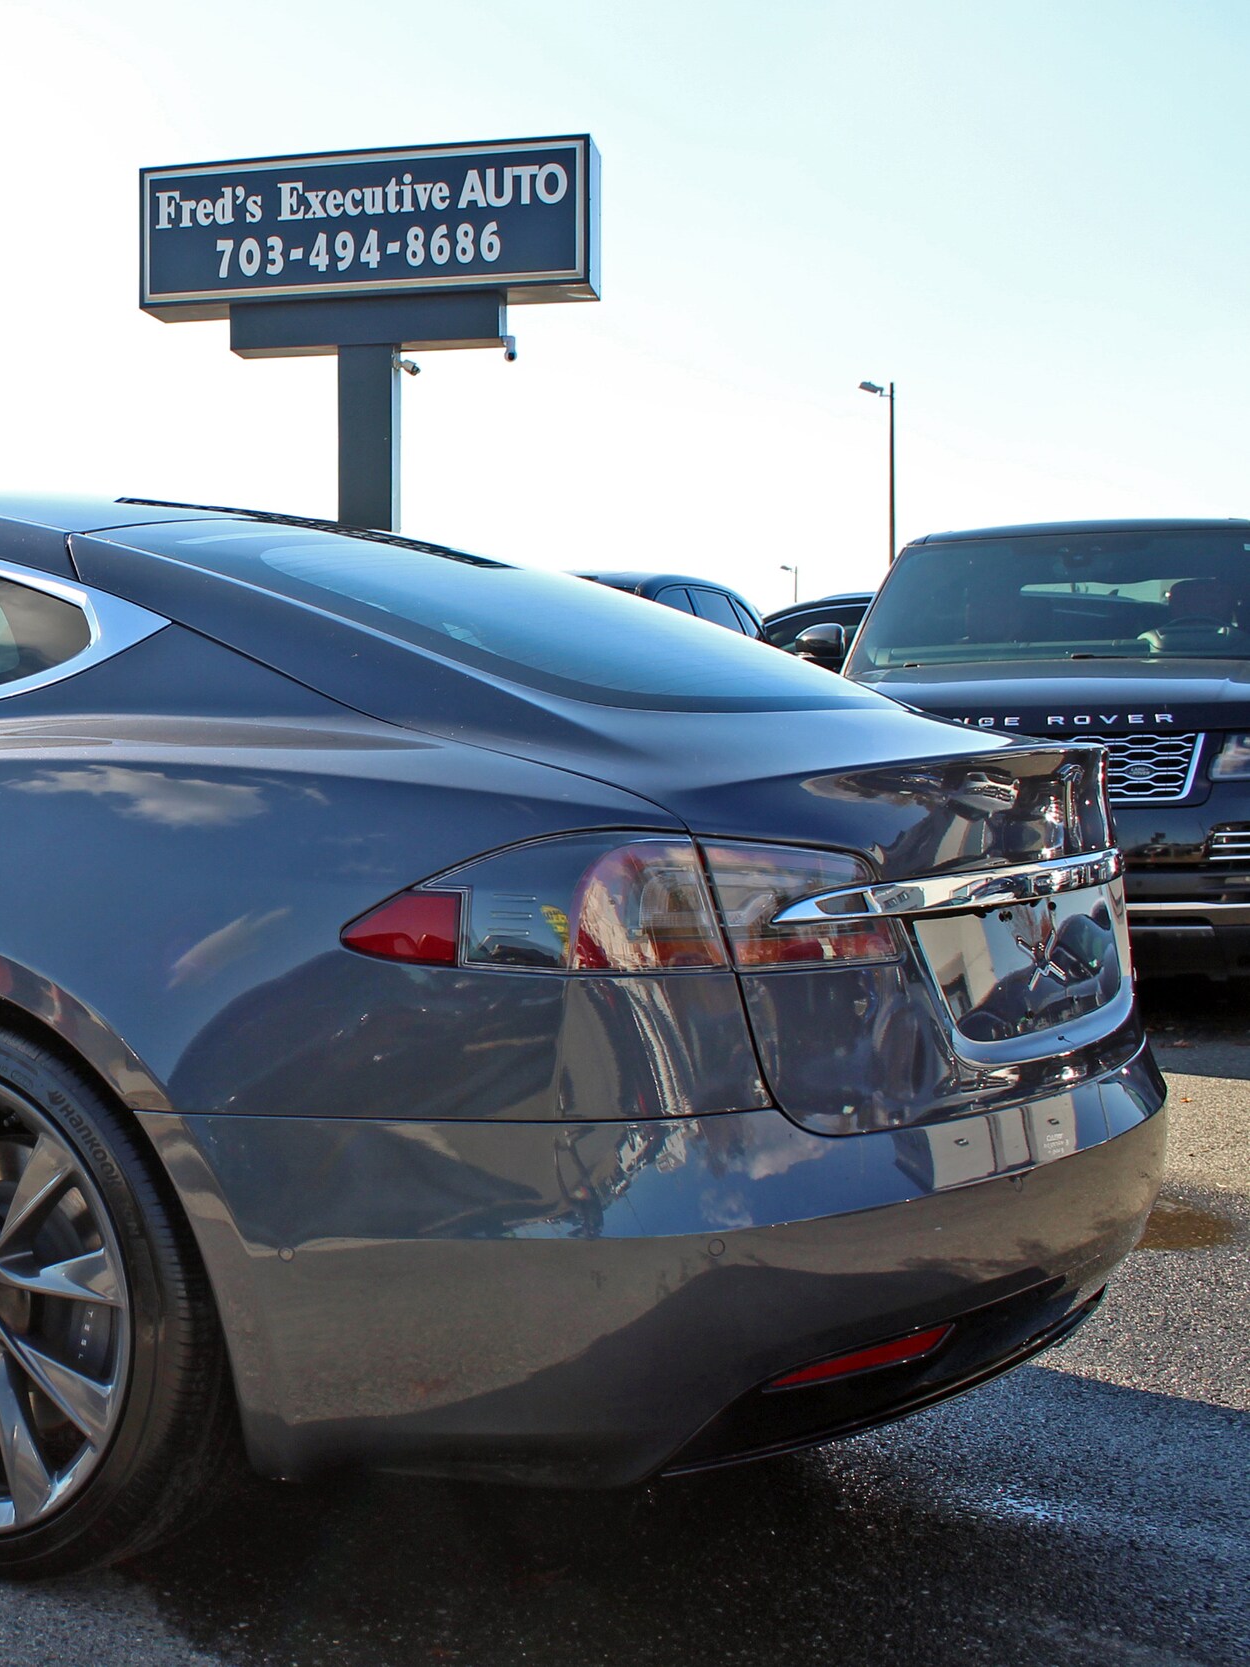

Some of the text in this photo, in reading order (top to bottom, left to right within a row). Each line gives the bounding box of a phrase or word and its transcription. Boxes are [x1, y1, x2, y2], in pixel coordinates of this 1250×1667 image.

[155, 162, 568, 230] Fred's Executive AUTO
[216, 221, 501, 278] 703-494-8686
[953, 713, 1173, 727] NGE ROVER
[78, 1311, 94, 1359] TESL
